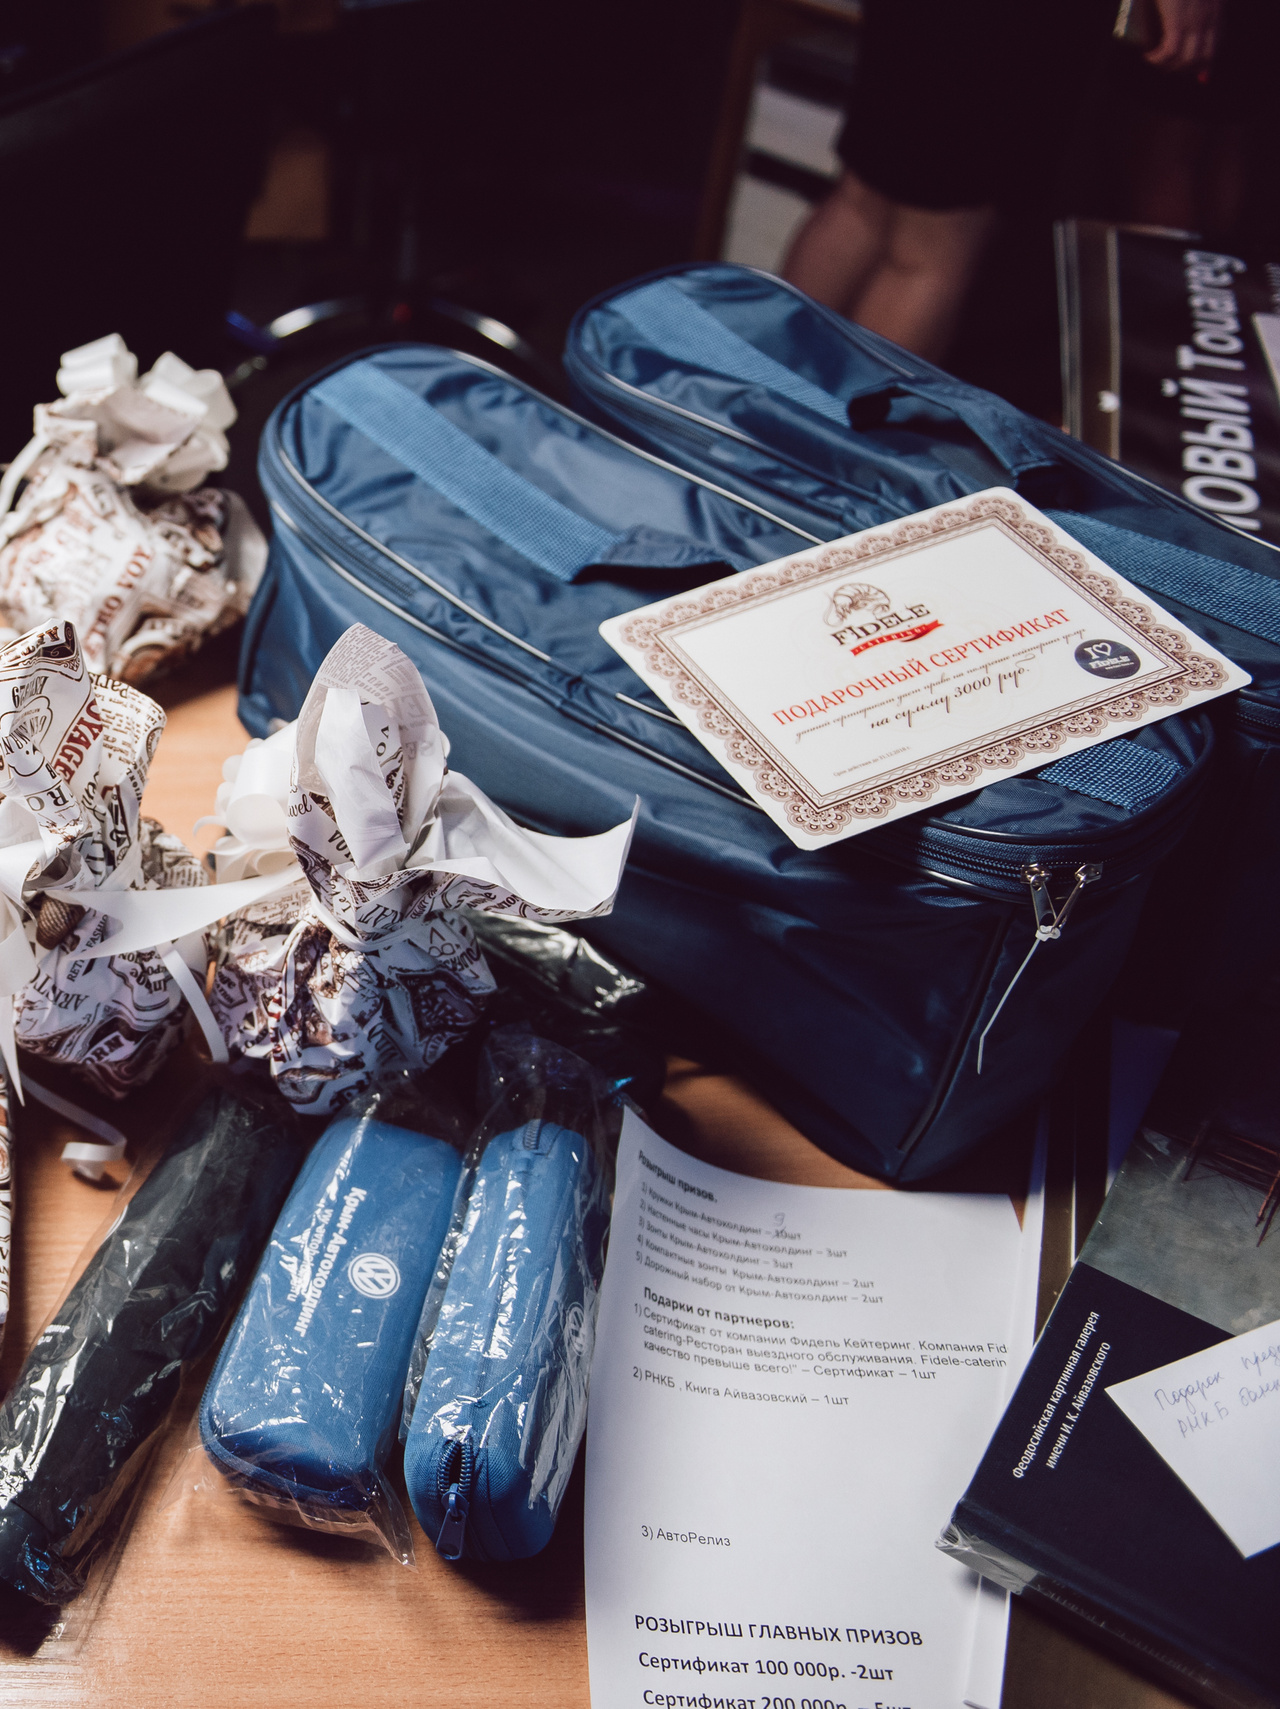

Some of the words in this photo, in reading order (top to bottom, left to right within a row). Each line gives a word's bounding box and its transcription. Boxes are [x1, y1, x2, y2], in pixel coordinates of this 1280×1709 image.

[1175, 250, 1247, 371] Touareg
[1161, 377, 1261, 531] ОВЫЙ
[831, 603, 931, 645] FIDELE
[772, 658, 930, 726] ПОДАРОЧНЫЙ
[929, 608, 1071, 667] СЕРТИФИКАТ
[870, 716, 890, 729] на
[894, 695, 951, 728] сумму
[953, 676, 991, 699] 3000
[638, 1149, 676, 1185] Розыгрыш
[647, 1203, 687, 1232] Настенные
[712, 1231, 813, 1256] Крым-Автохолдинг
[674, 1201, 762, 1235] Крым-Автохолдинг
[293, 1186, 368, 1338] Крым-Автохолдинг
[645, 1238, 695, 1268] Компактные
[698, 1261, 728, 1275] зонты
[732, 1268, 839, 1288] Крым-Автохолдинг
[853, 1278, 875, 1289] 2шт
[646, 1221, 669, 1240] Зонты
[669, 1232, 760, 1266] Крым-Автохолдинг
[644, 1256, 690, 1282] Дорожный
[691, 1276, 722, 1291] набор
[725, 1283, 736, 1293] от
[738, 1283, 848, 1304] Крым-Автохолдинг
[861, 1293, 884, 1304] 2шт
[634, 1303, 642, 1318] 1)
[643, 1306, 706, 1335] Сертификат
[709, 1327, 723, 1338] от
[726, 1330, 787, 1346] компании
[789, 1332, 841, 1349] Фидель
[844, 1338, 915, 1352] Кейтеринг.
[918, 1340, 985, 1354] Компания
[644, 1286, 694, 1314] Подарки
[697, 1306, 711, 1318] от
[714, 1310, 795, 1330] партнеров:
[643, 1324, 743, 1356] catering-Ресторан
[746, 1349, 814, 1362] выездного
[817, 1351, 917, 1365] обслуживания.
[643, 1339, 691, 1362] качество
[693, 1353, 751, 1372] превыше
[813, 1365, 895, 1379] Сертификат
[911, 1368, 937, 1380] 1шт
[632, 1366, 644, 1382] 2)
[644, 1370, 676, 1389] РНКБ
[685, 1380, 721, 1397] Книга
[723, 1387, 808, 1404] Айвазовский
[824, 1394, 850, 1405] 1шт
[1012, 1402, 1057, 1480] Феодосийская
[1049, 1349, 1082, 1406] картинная
[1074, 1311, 1101, 1352] галерея
[1071, 1341, 1112, 1413] Айвазовского
[1059, 1421, 1075, 1435] И.
[1065, 1410, 1081, 1424] К.
[1045, 1431, 1070, 1470] имени
[641, 1525, 654, 1541] 3)
[656, 1527, 731, 1547] АвтоРелиз
[634, 1614, 744, 1638] РОЗЫГРЫШ
[748, 1623, 842, 1643] ГЛАВНЫХ
[846, 1628, 924, 1646] ПРИЗОВ
[638, 1652, 750, 1675] Сертификат
[755, 1659, 789, 1676] 100
[794, 1661, 846, 1682] 000р.
[643, 1689, 756, 1709] Сертификат
